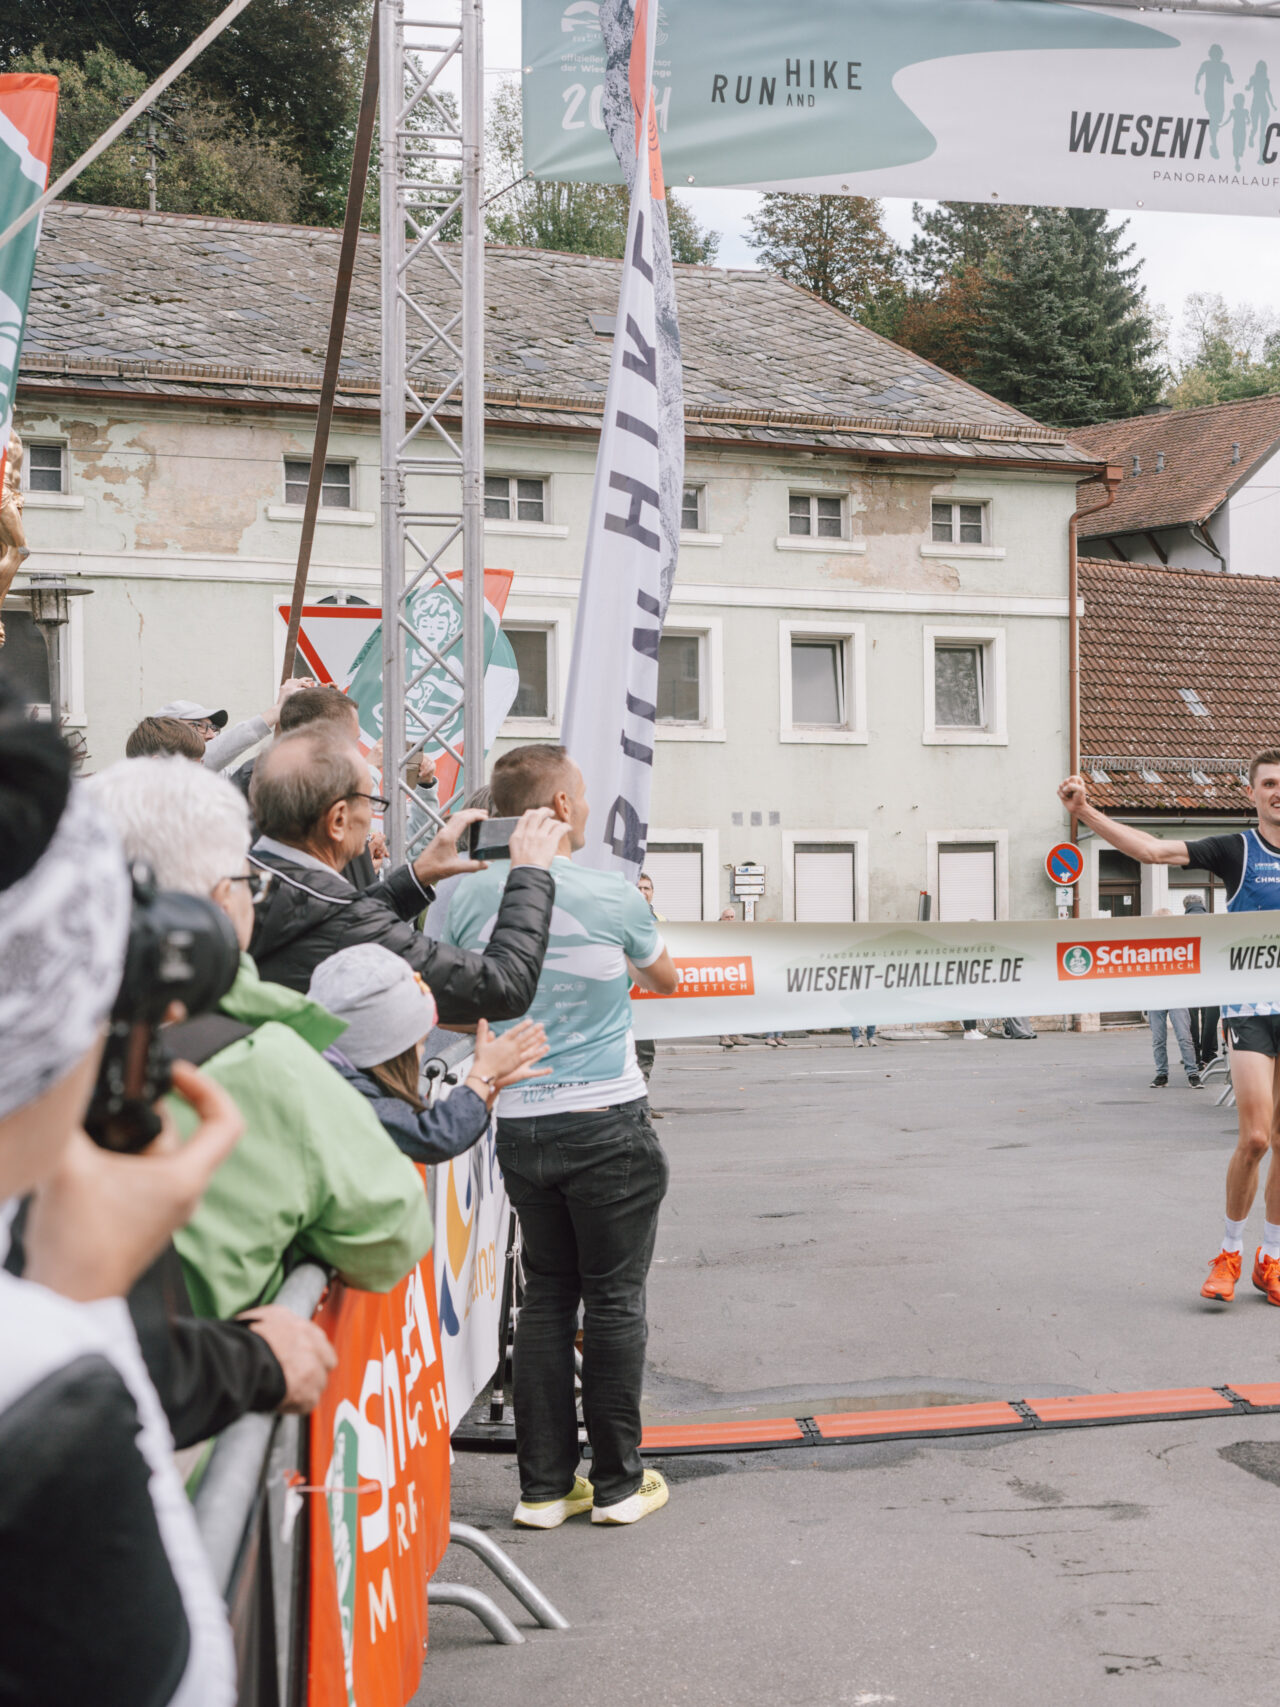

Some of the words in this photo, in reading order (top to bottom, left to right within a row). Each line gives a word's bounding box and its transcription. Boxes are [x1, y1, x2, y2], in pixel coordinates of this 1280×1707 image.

[560, 53, 604, 64] offizieller
[711, 74, 776, 105] RUN
[786, 58, 862, 90] HIKE
[562, 83, 672, 133] 204
[786, 93, 815, 107] AND
[1068, 111, 1210, 160] WIESENT
[1153, 171, 1280, 187] PANORAMALAUF
[1096, 943, 1194, 966] Schamel
[787, 957, 1024, 993] WIESENT-CHALLENGE.DE
[1096, 962, 1194, 974] MEERRETTICH
